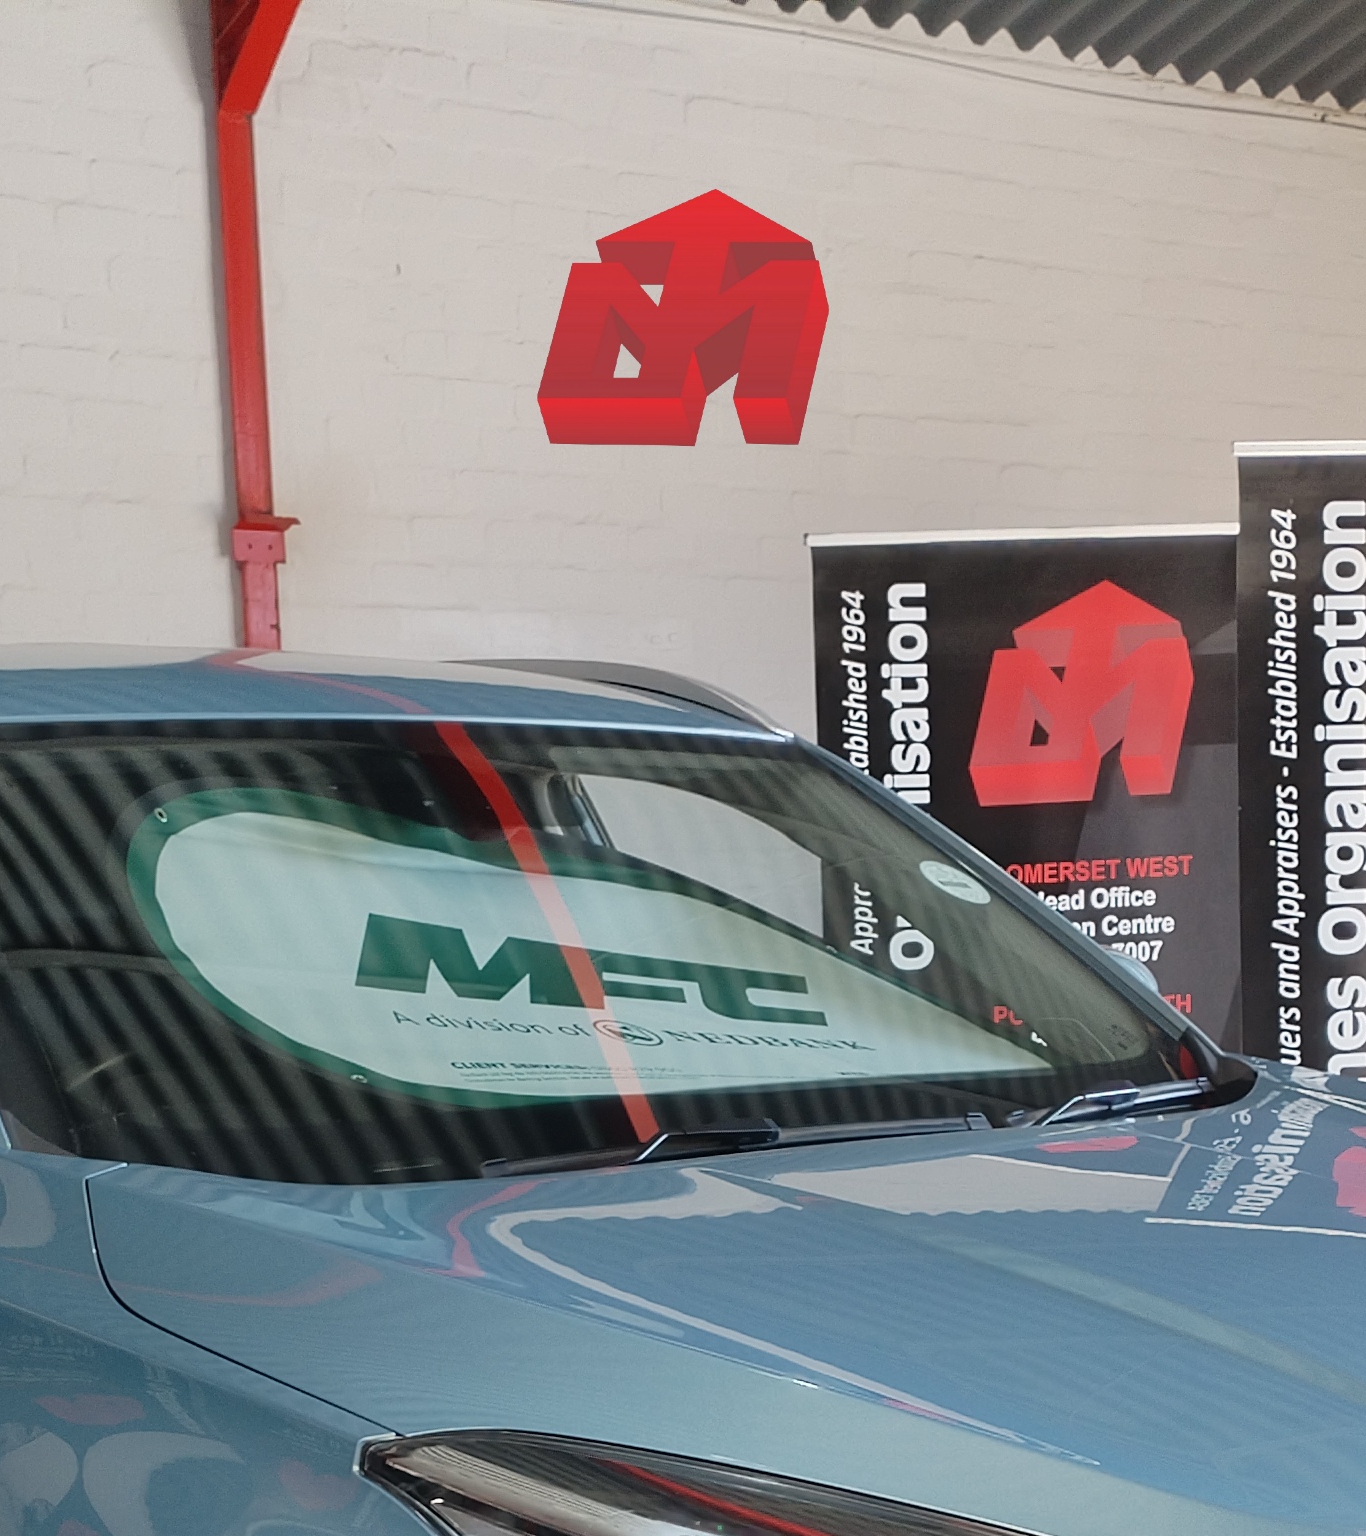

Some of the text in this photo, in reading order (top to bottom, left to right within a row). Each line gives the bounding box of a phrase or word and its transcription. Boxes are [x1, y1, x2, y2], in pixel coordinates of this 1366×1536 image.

[1269, 509, 1297, 583] 1964
[841, 590, 869, 776] ablished 1964
[1267, 591, 1298, 759] Established
[1006, 859, 1121, 885] OMERSET
[1125, 854, 1193, 880] WEST
[1269, 784, 1306, 938] Appraisers
[1090, 886, 1157, 909] Office
[1101, 914, 1176, 936] Centre
[355, 913, 828, 1026] MFC
[1270, 943, 1301, 999] and
[392, 1010, 876, 1051] A division of NEDBANK
[1279, 1006, 1302, 1066] uers
